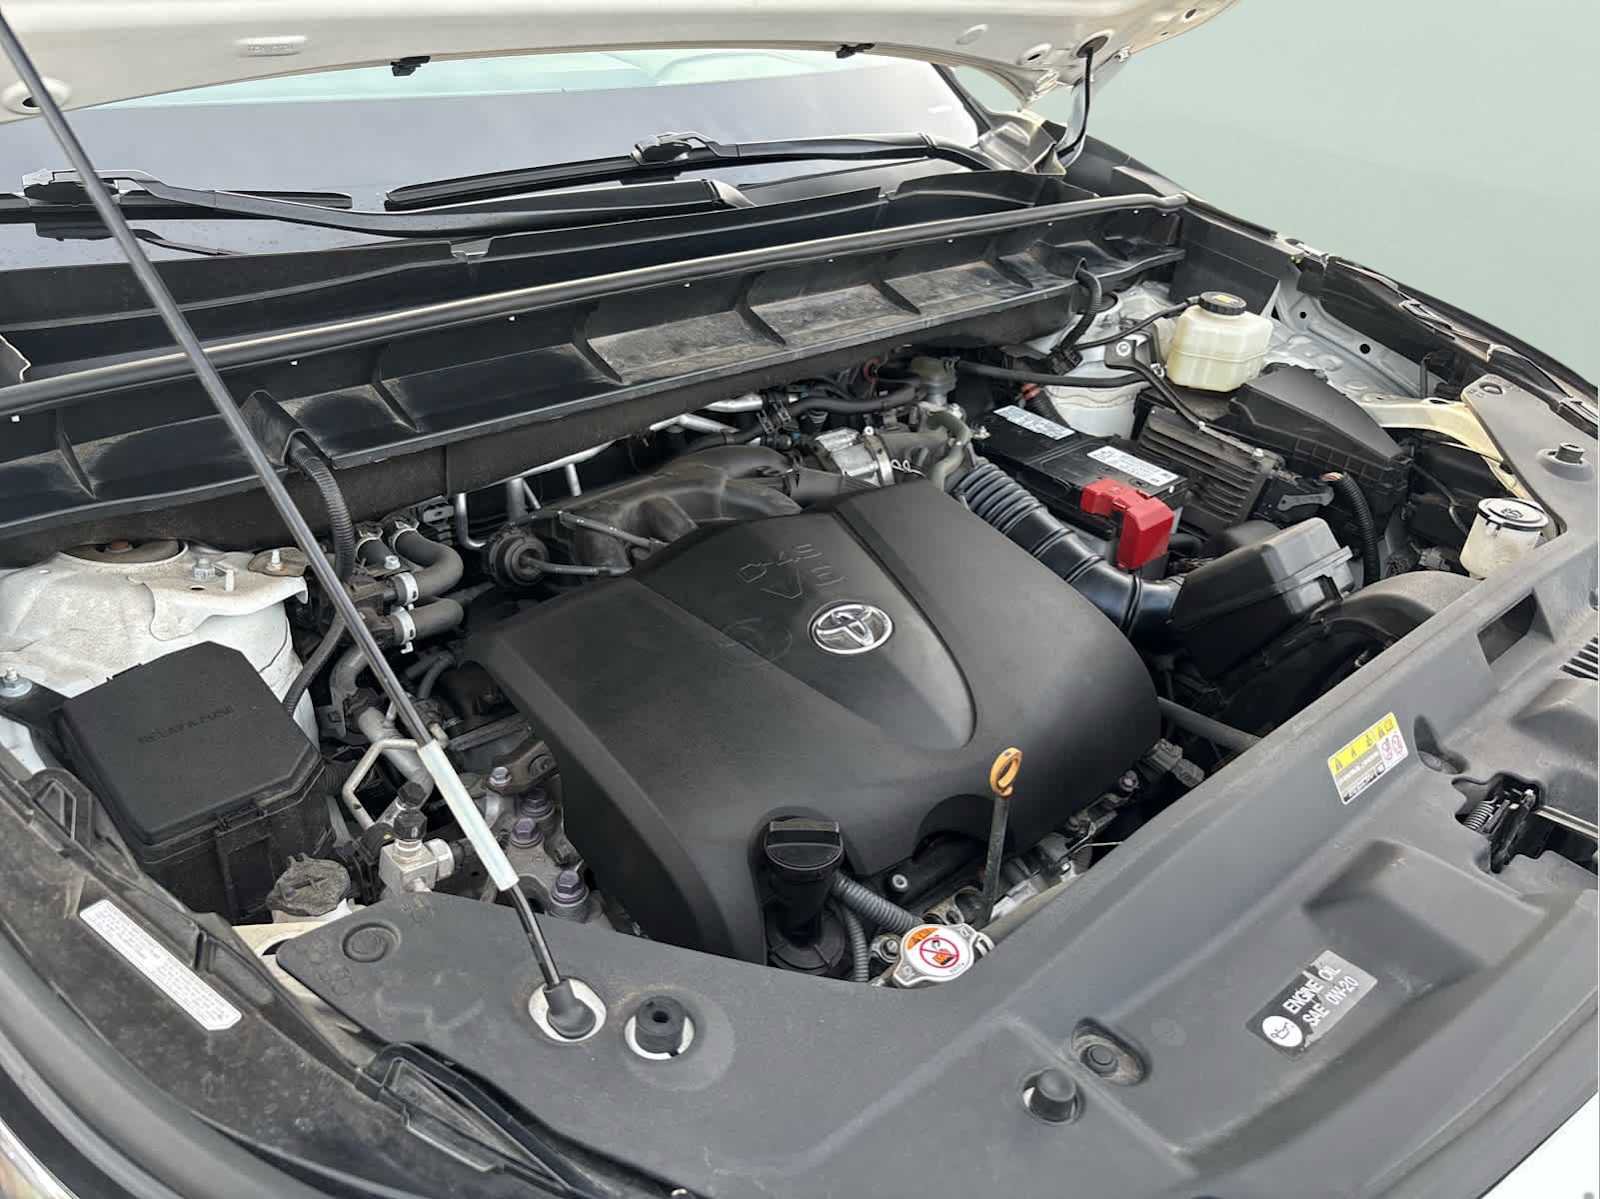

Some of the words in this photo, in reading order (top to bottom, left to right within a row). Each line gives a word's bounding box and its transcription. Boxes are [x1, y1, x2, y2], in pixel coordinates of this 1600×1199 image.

[1282, 978, 1325, 1015] ENGINE
[1317, 964, 1342, 982] OIL
[1302, 1002, 1331, 1027] SAE
